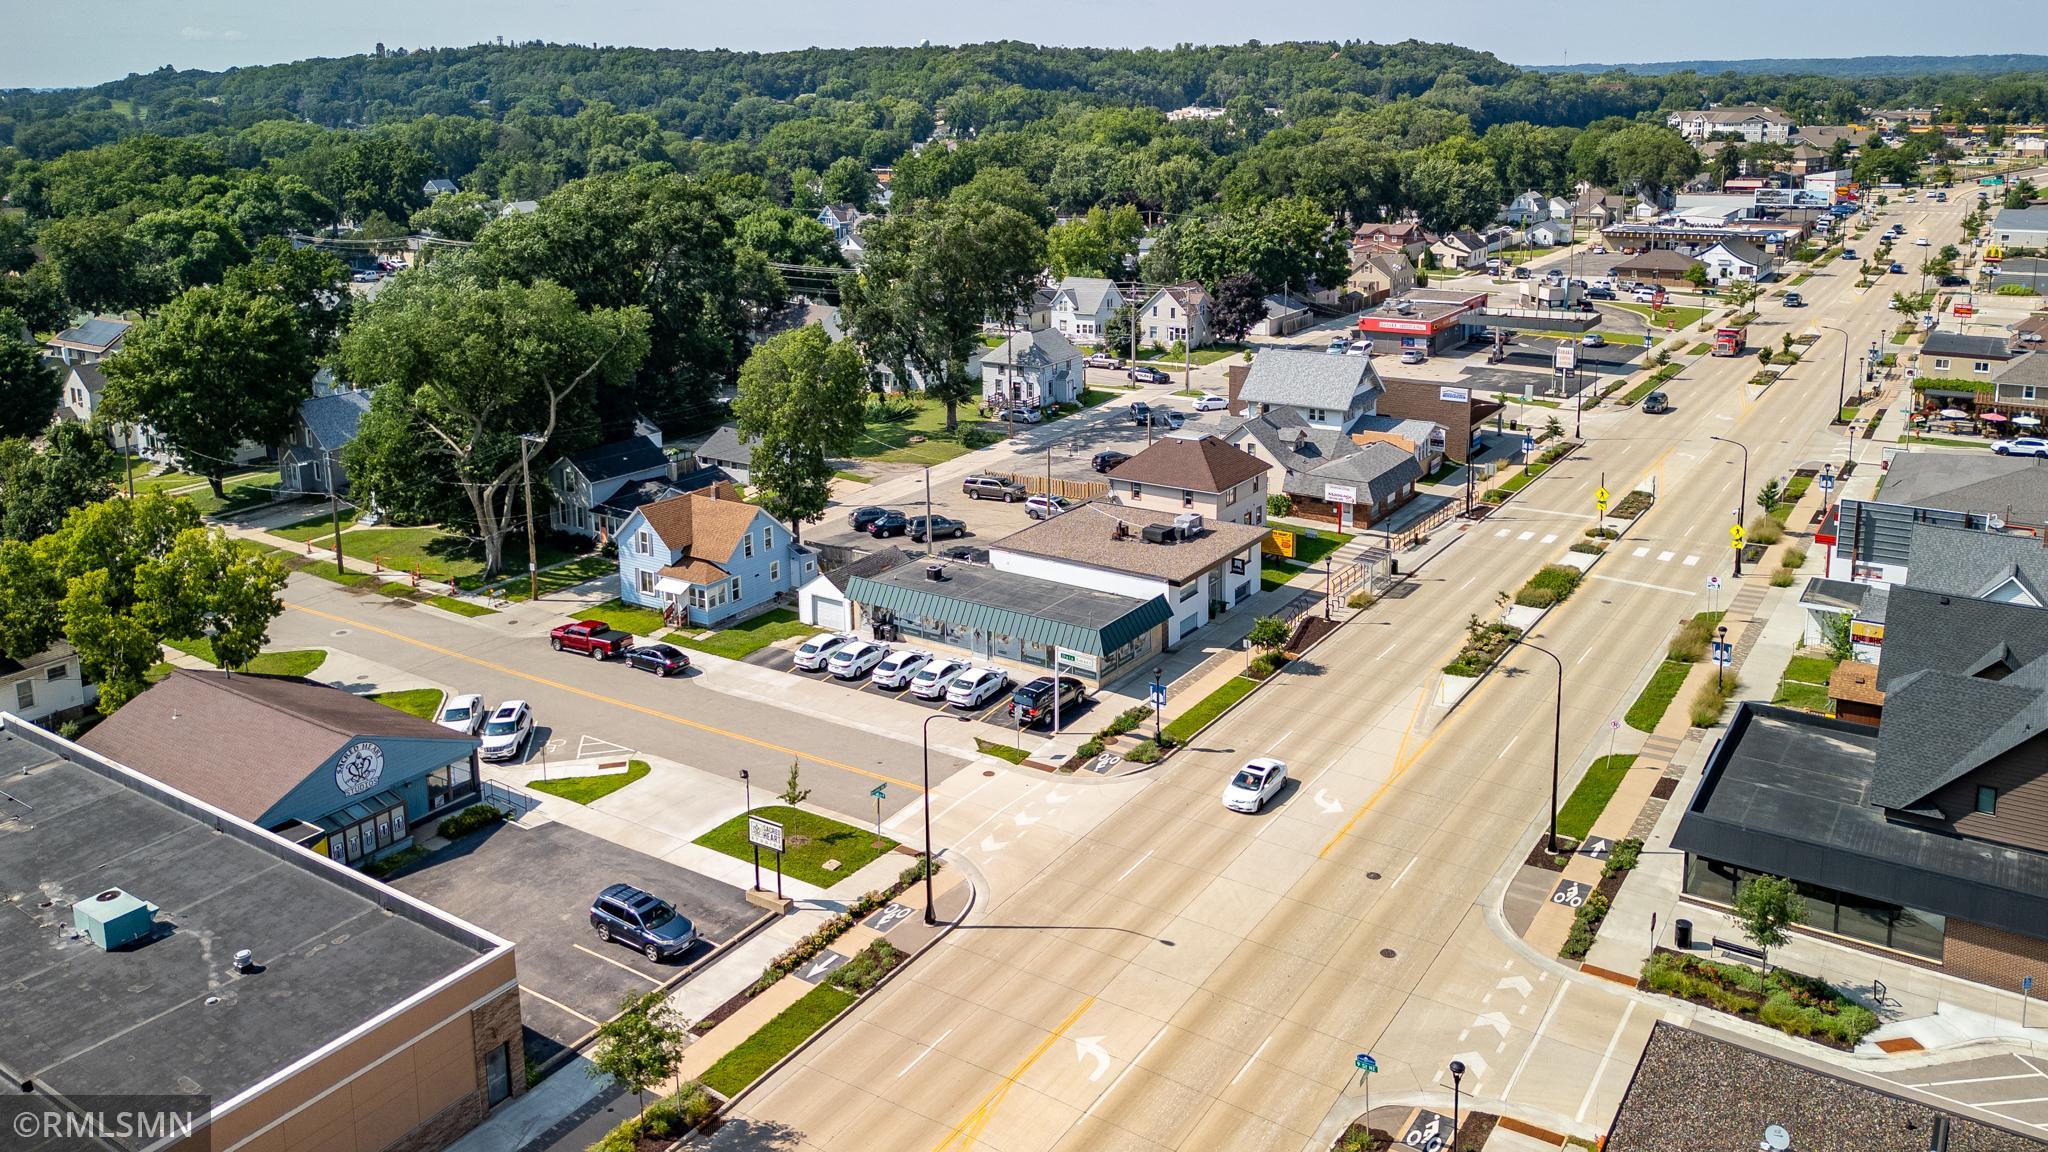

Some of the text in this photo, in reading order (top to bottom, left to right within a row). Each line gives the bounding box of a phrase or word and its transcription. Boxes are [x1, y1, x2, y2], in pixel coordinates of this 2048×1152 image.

[337, 743, 383, 774] SACRED HEART
[346, 776, 379, 795] STUDIOS
[763, 824, 781, 837] SACRED
[763, 831, 781, 845] HEART
